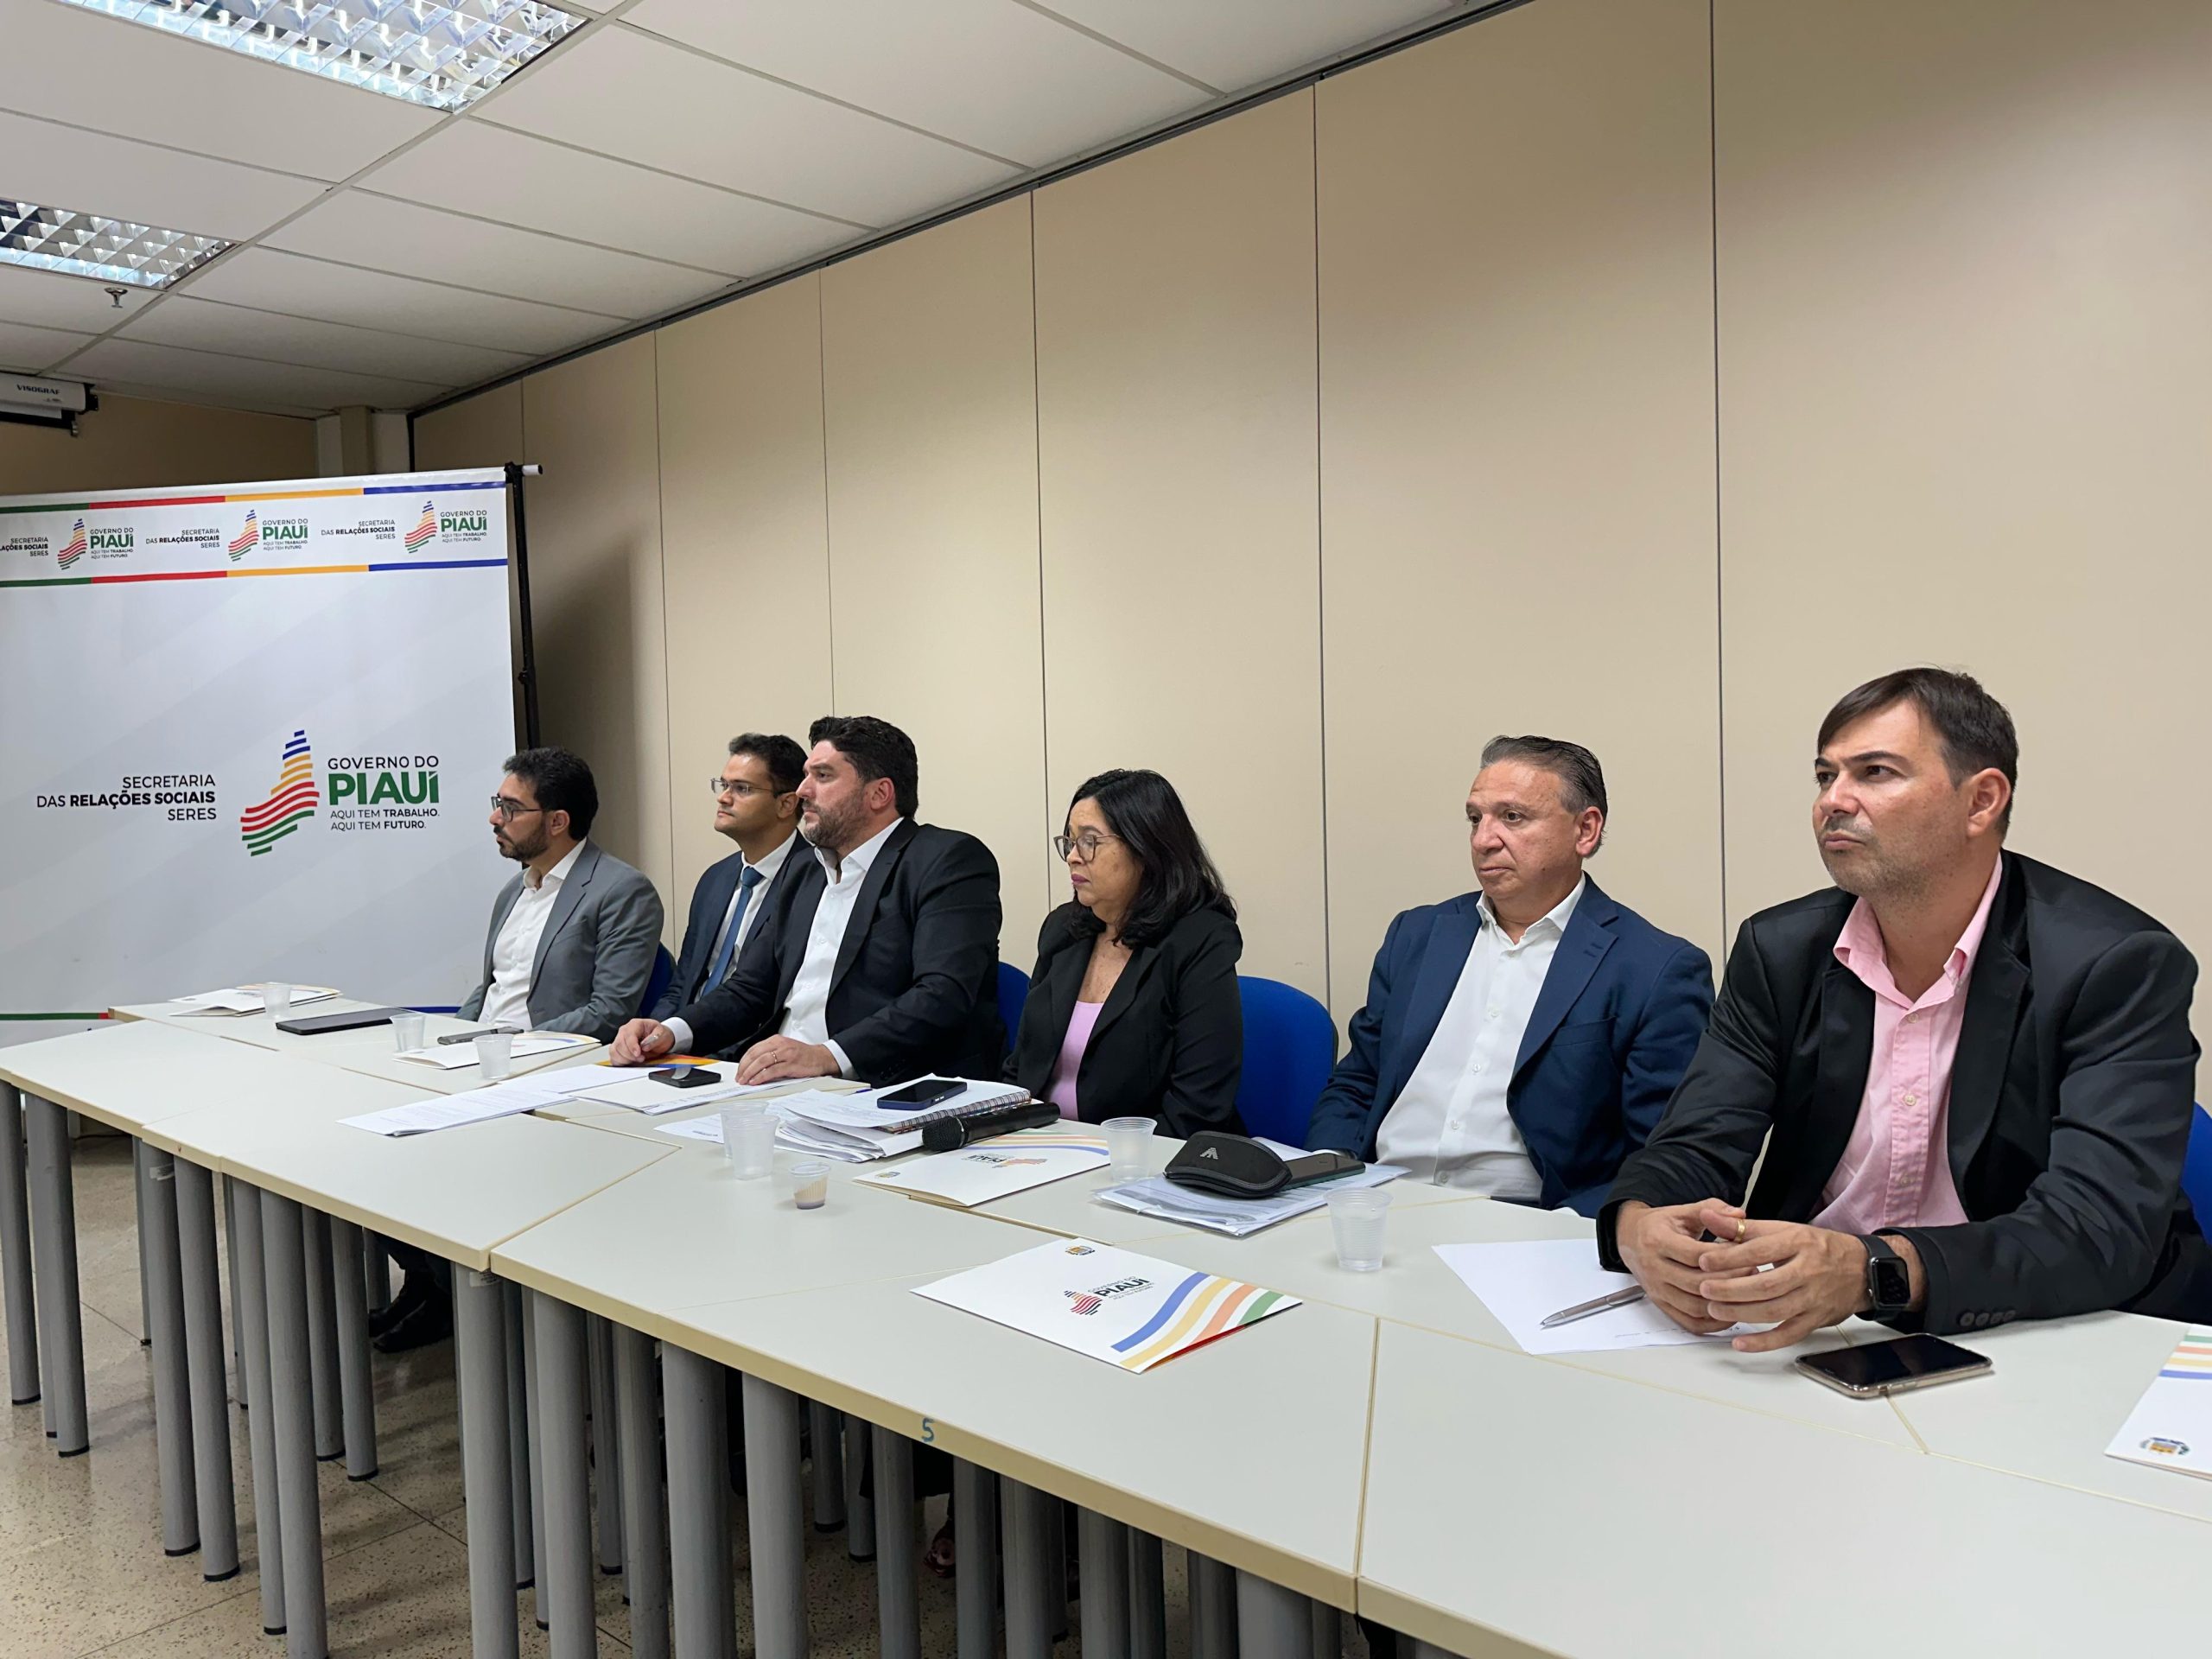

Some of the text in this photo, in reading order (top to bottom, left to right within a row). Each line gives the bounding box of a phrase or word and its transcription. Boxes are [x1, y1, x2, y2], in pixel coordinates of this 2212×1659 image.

[16, 385, 60, 395] VISOGRAF
[441, 518, 487, 532] PIAUÍ
[159, 535, 194, 543] RELAÇÕES
[263, 525, 308, 540] PIAUÍ
[90, 533, 134, 549] PIAUÍ
[327, 755, 439, 769] GOVERNO DO
[122, 774, 216, 788] SECRETARIA
[328, 771, 439, 805] PIAUÍ
[36, 790, 216, 809] DAS RELAÇÕES SOCIAIS
[168, 808, 217, 821] SERES
[330, 810, 355, 820] AQUI
[383, 808, 440, 817] TRABALHO.
[331, 822, 356, 832] AQUI
[384, 820, 426, 830] FUTURO.
